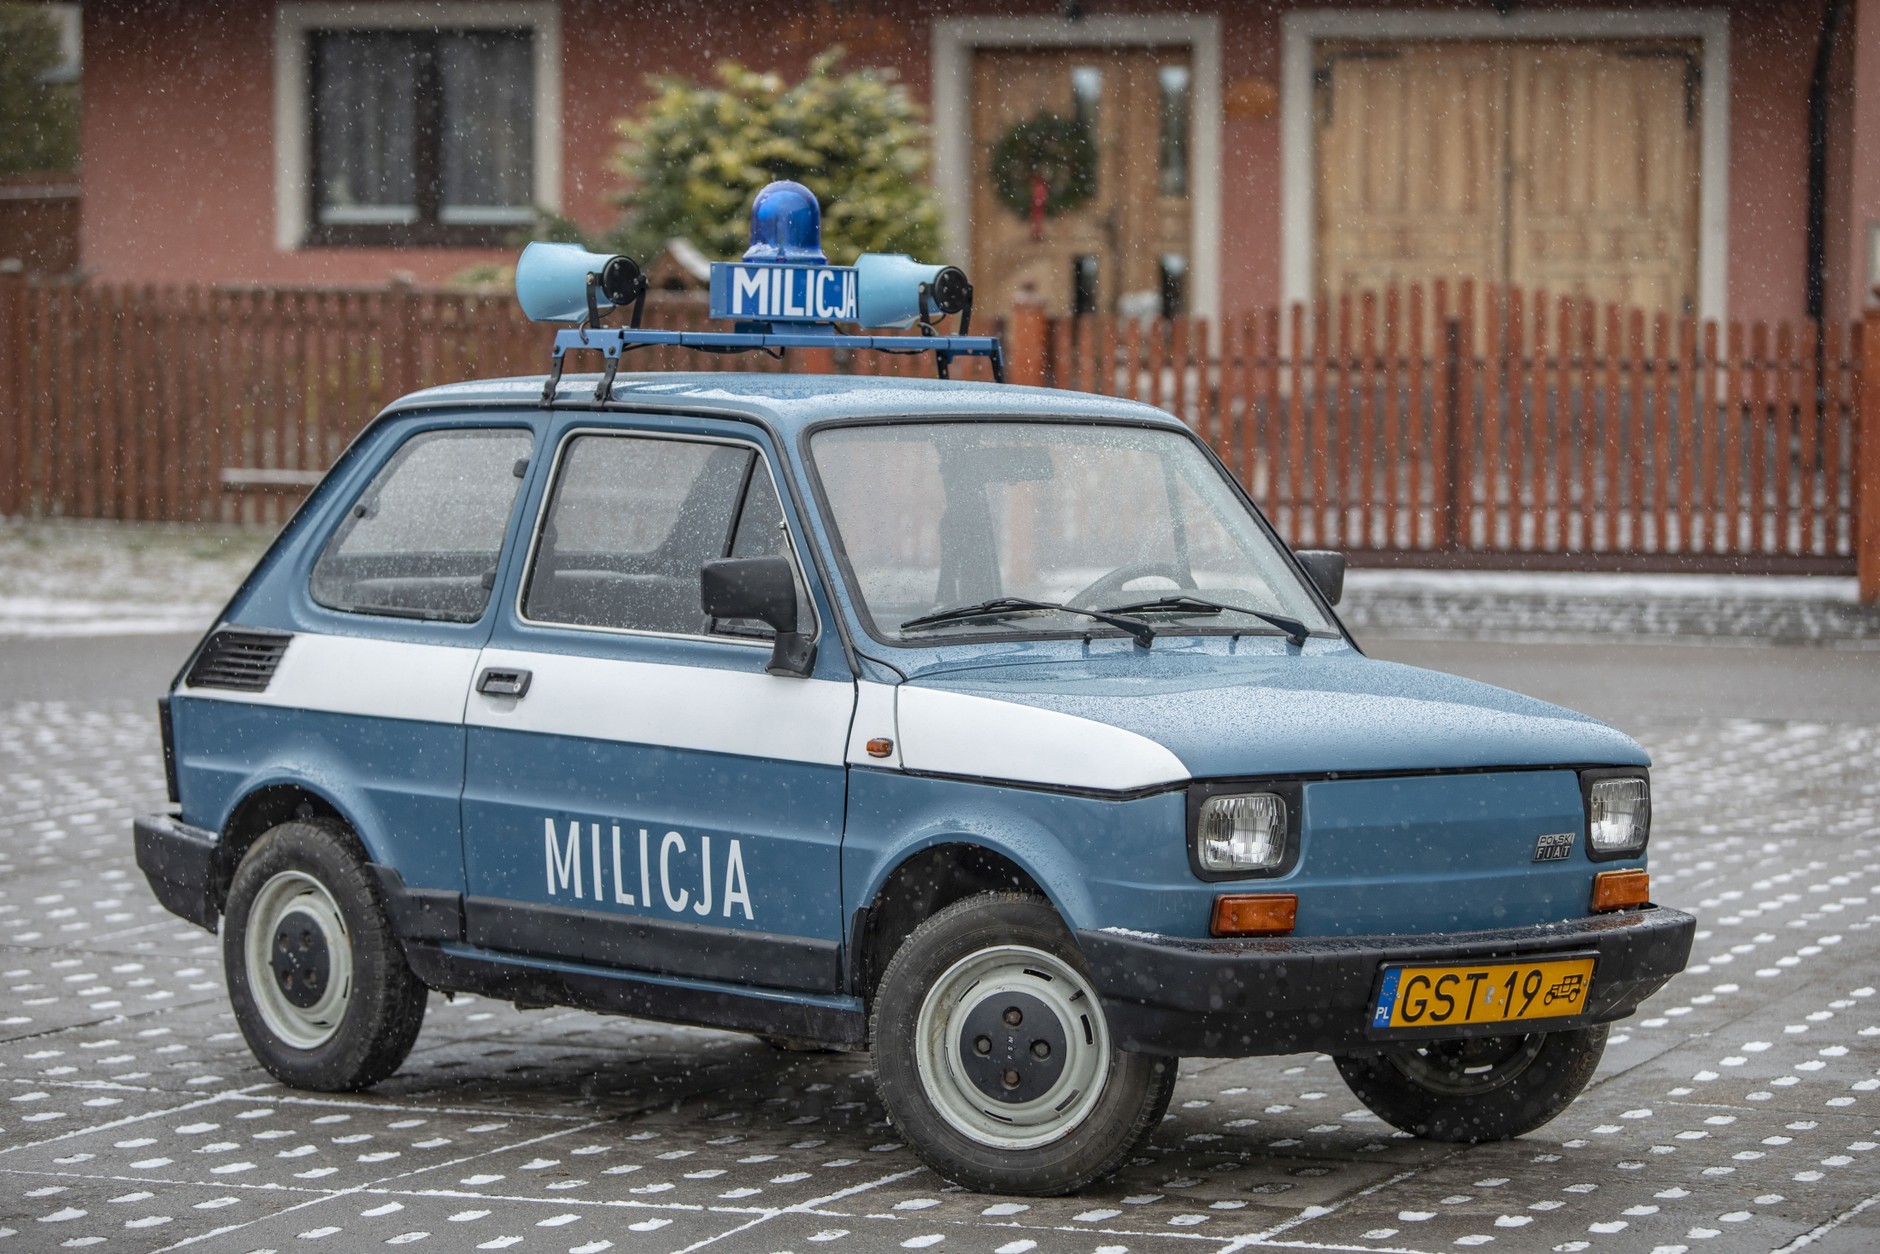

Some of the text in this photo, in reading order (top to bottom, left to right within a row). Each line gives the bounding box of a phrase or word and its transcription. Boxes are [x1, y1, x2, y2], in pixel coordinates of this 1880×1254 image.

[732, 267, 857, 318] MILICJA
[1536, 845, 1570, 859] FIAT
[1540, 834, 1574, 845] POLSKI
[545, 818, 754, 920] MILICJA
[1401, 969, 1543, 1023] GST 19
[1375, 1006, 1390, 1020] PL
